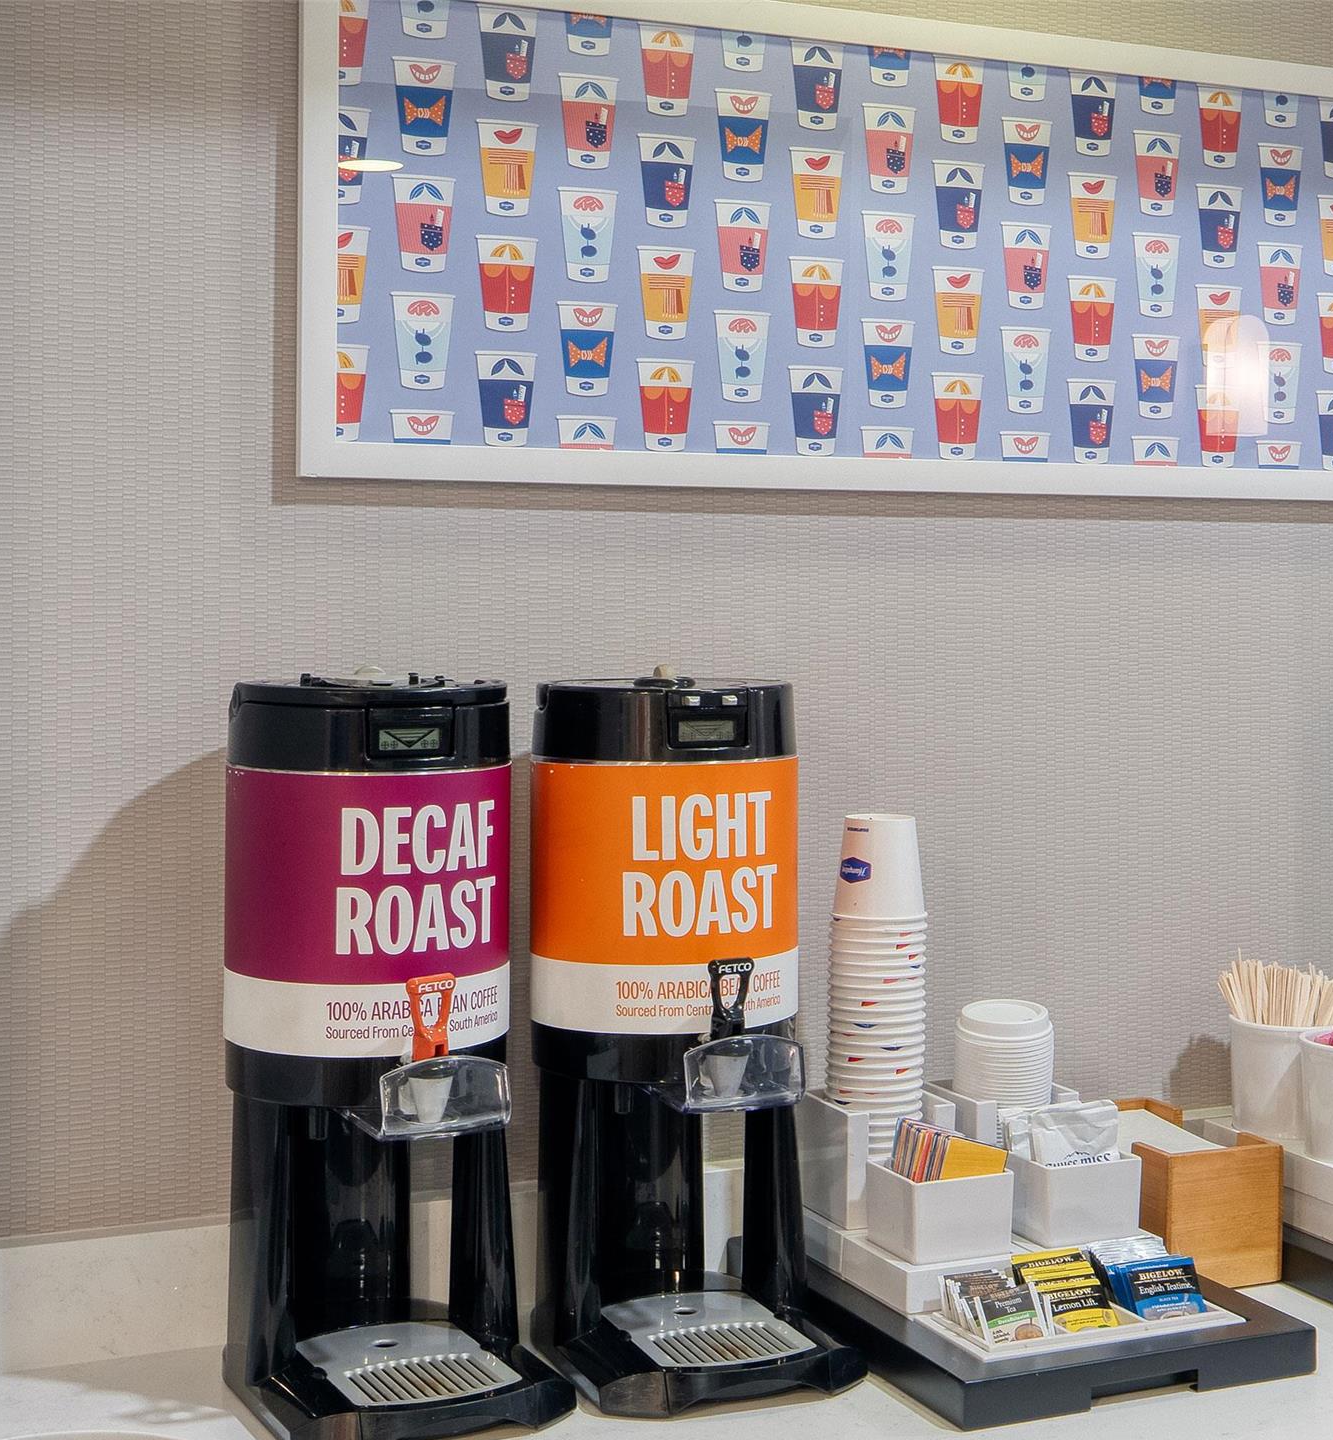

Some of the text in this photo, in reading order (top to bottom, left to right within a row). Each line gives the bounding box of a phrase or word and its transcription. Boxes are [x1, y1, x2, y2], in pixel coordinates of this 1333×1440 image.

[632, 790, 772, 861] LIGHT
[340, 799, 495, 876] DECAF
[622, 863, 778, 938] ROAST
[335, 875, 496, 955] ROAST
[718, 962, 752, 974] FETCO
[418, 979, 454, 994] FETCO
[616, 980, 654, 1001] 100%
[753, 970, 781, 993] COFFEE
[326, 1001, 367, 1021] 100%
[370, 998, 433, 1021] ARABCA
[470, 984, 498, 1010] COFFEE
[616, 1004, 657, 1018] Sourced
[659, 1004, 684, 1017] From
[686, 1003, 714, 1016] Centr
[325, 1026, 370, 1040] Sourced
[372, 1026, 399, 1039] From
[449, 1015, 473, 1032] South
[473, 1009, 498, 1028] America
[1139, 1268, 1184, 1281] BIGELOW
[1138, 1283, 1166, 1296] English
[994, 1297, 1023, 1309] Premium
[1006, 1306, 1017, 1314] Tea
[1052, 1298, 1095, 1312] Lemon Lift
